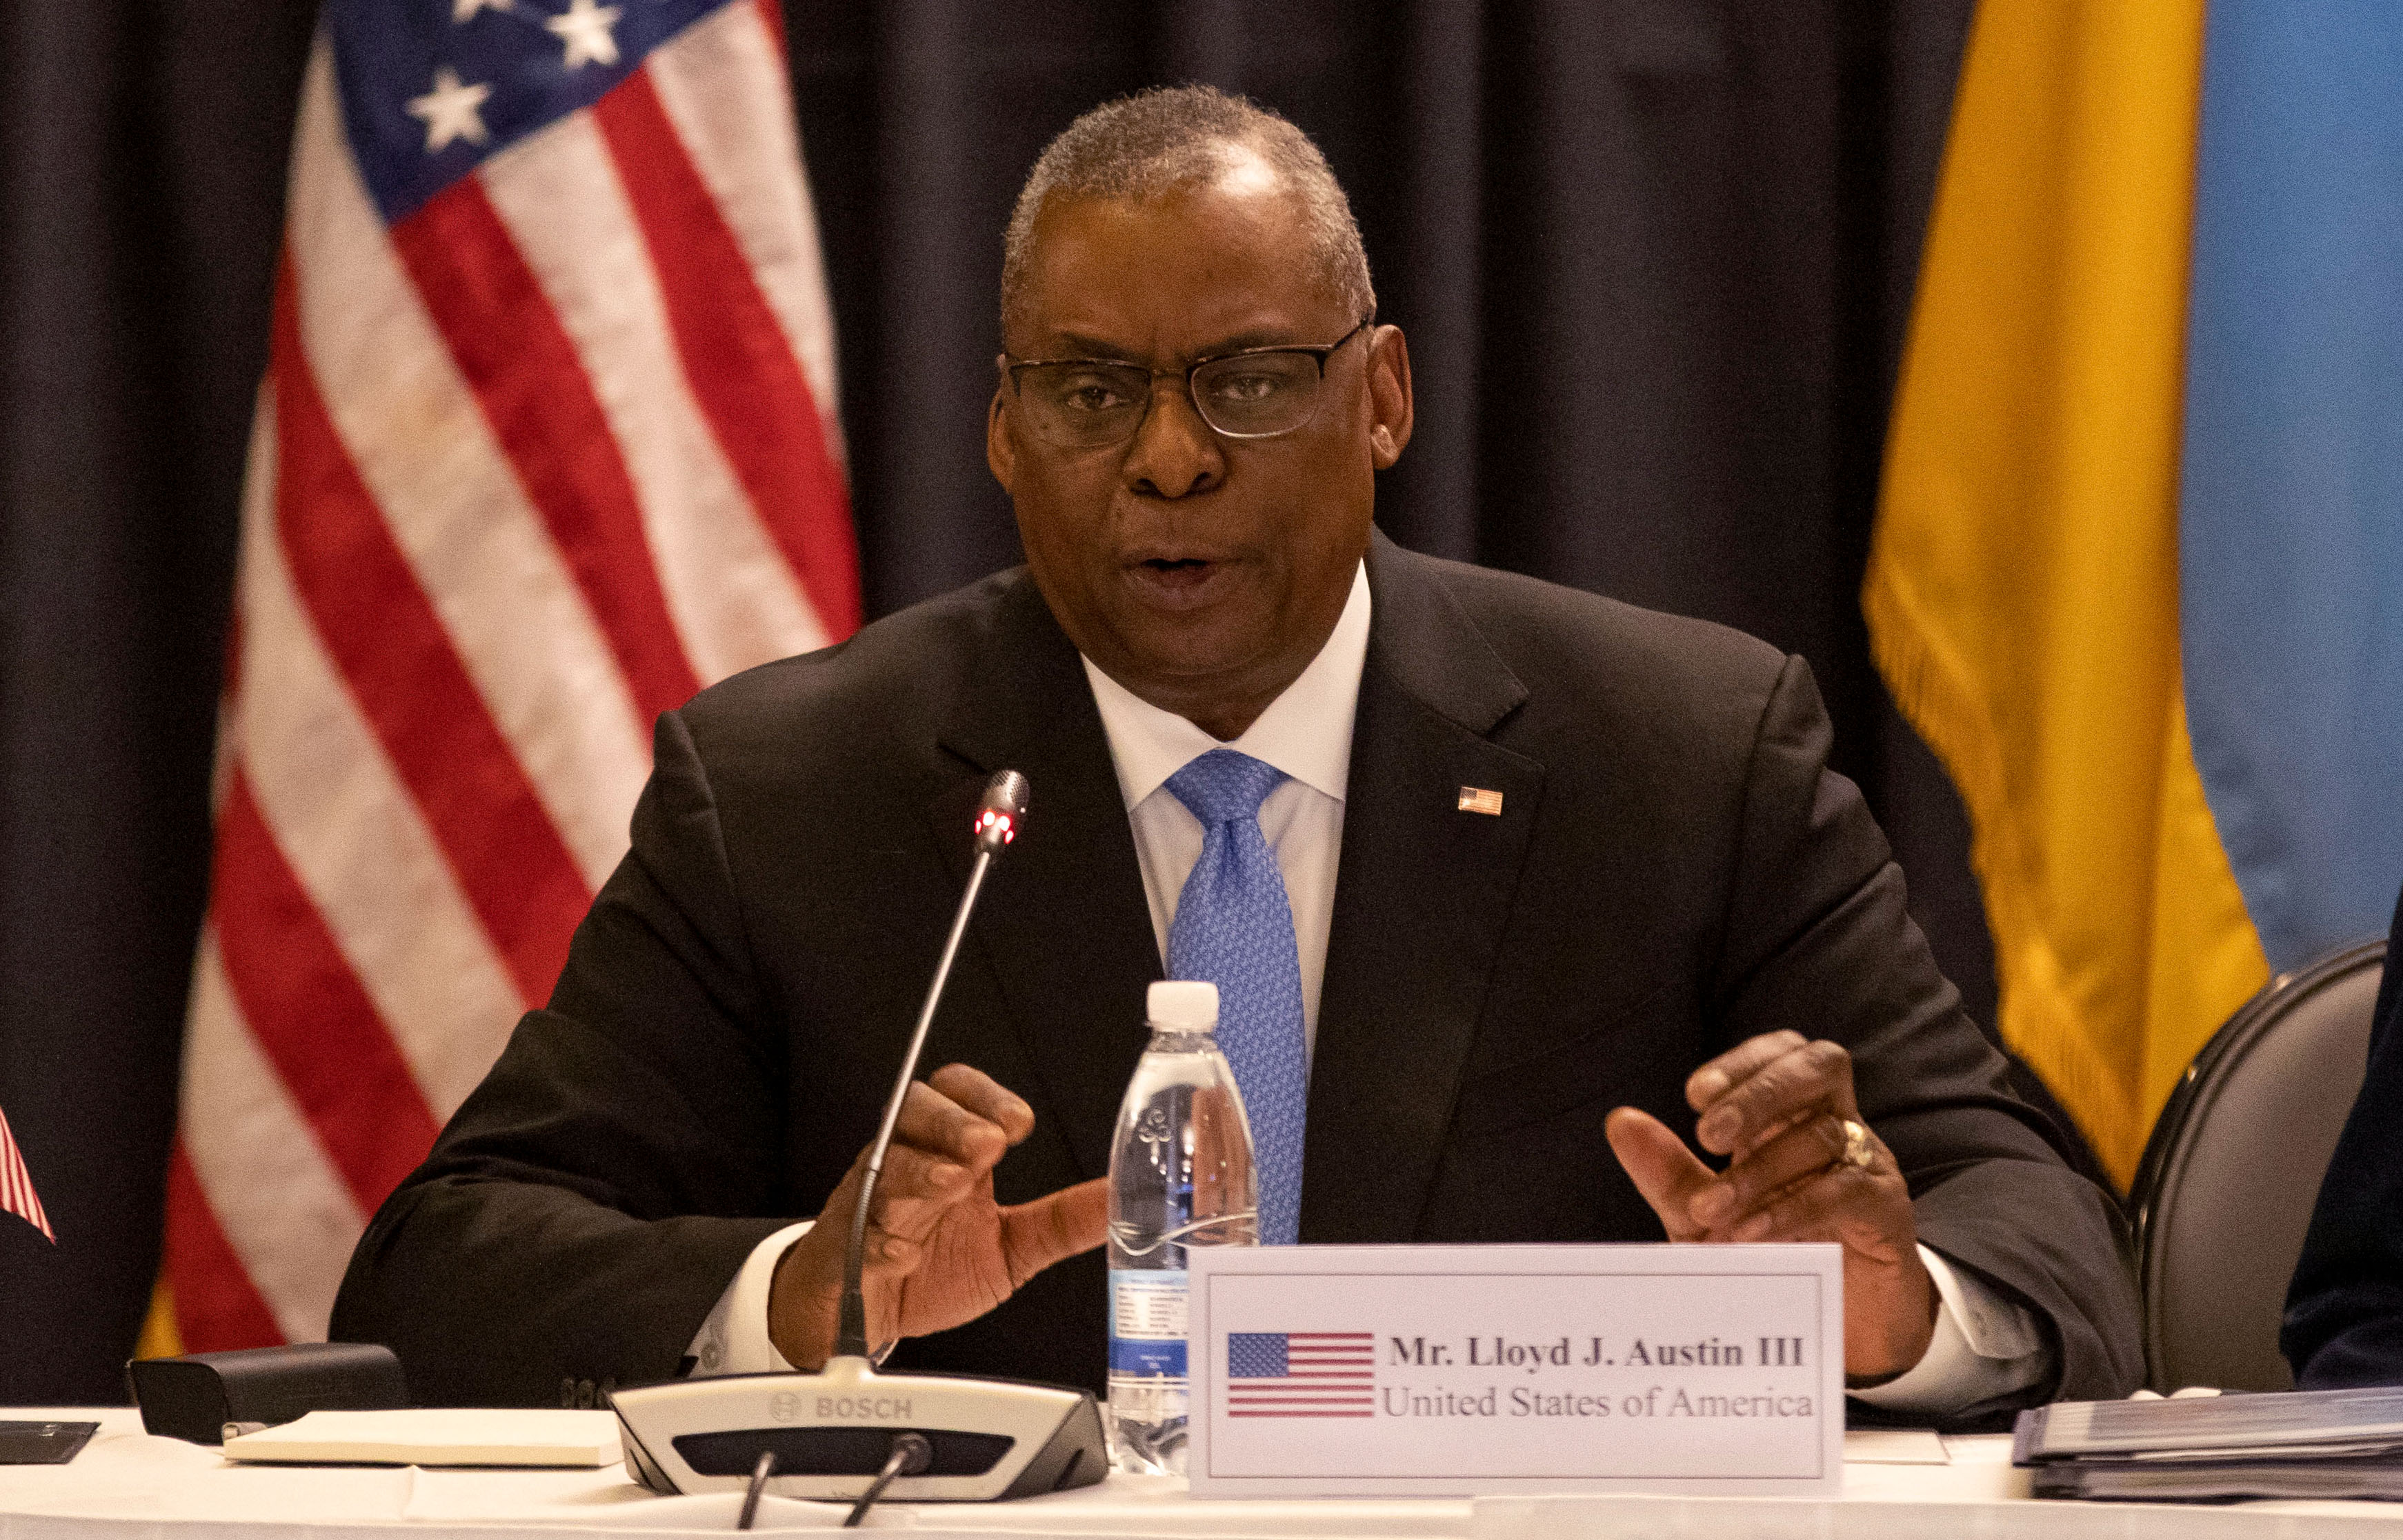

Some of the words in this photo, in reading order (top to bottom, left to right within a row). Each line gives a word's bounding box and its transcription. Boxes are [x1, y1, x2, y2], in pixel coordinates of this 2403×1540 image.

[1389, 1337, 1453, 1367] Mr.
[1468, 1337, 1571, 1374] Lloyd
[1583, 1337, 1614, 1367] J.
[1625, 1337, 1743, 1367] Austin
[1758, 1337, 1804, 1367] III
[815, 1397, 912, 1419] BOSCH
[1383, 1387, 1497, 1417] United
[1510, 1387, 1611, 1417] States
[1622, 1386, 1663, 1417] of
[1666, 1388, 1814, 1417] America
